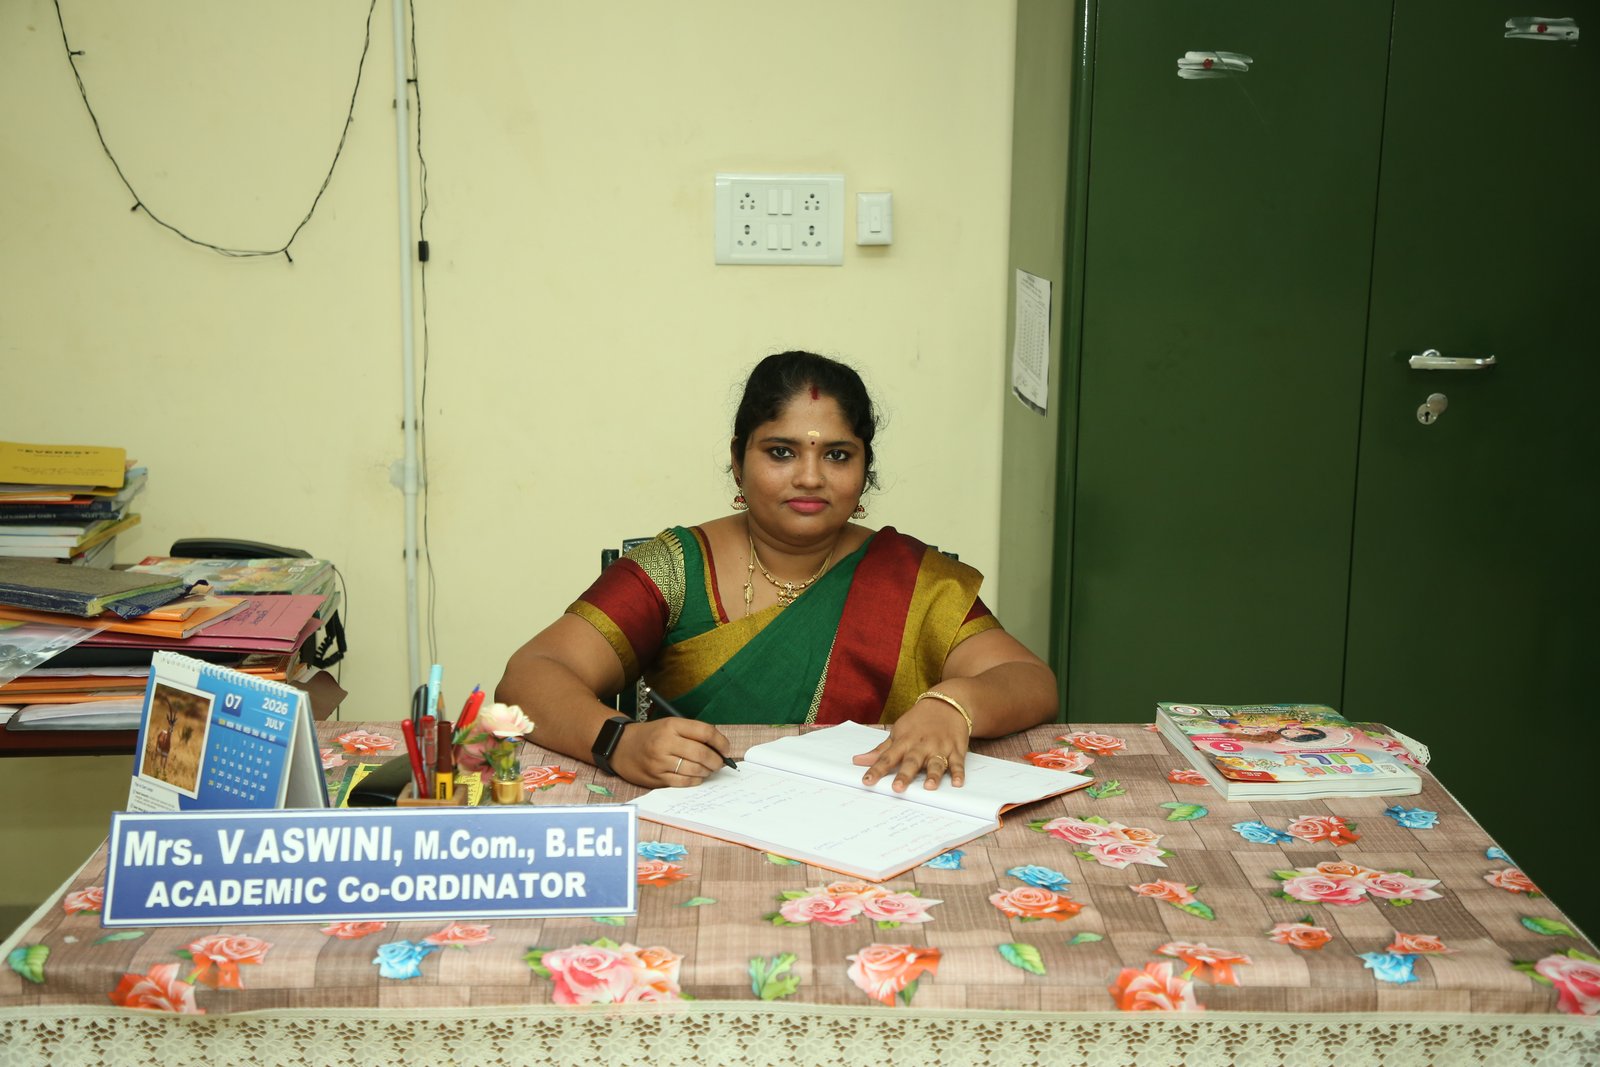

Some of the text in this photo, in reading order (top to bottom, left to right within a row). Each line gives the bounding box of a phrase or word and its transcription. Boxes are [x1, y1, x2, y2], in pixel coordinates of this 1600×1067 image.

[225, 693, 242, 710] 07
[261, 697, 289, 715] 2026
[264, 717, 285, 731] JULY
[1283, 752, 1374, 767] LILY
[124, 825, 623, 867] Mrs. V.ASWINI, M.Com., B.Ed.
[145, 871, 587, 908] ACADEMIC Co-ORDINATOR
